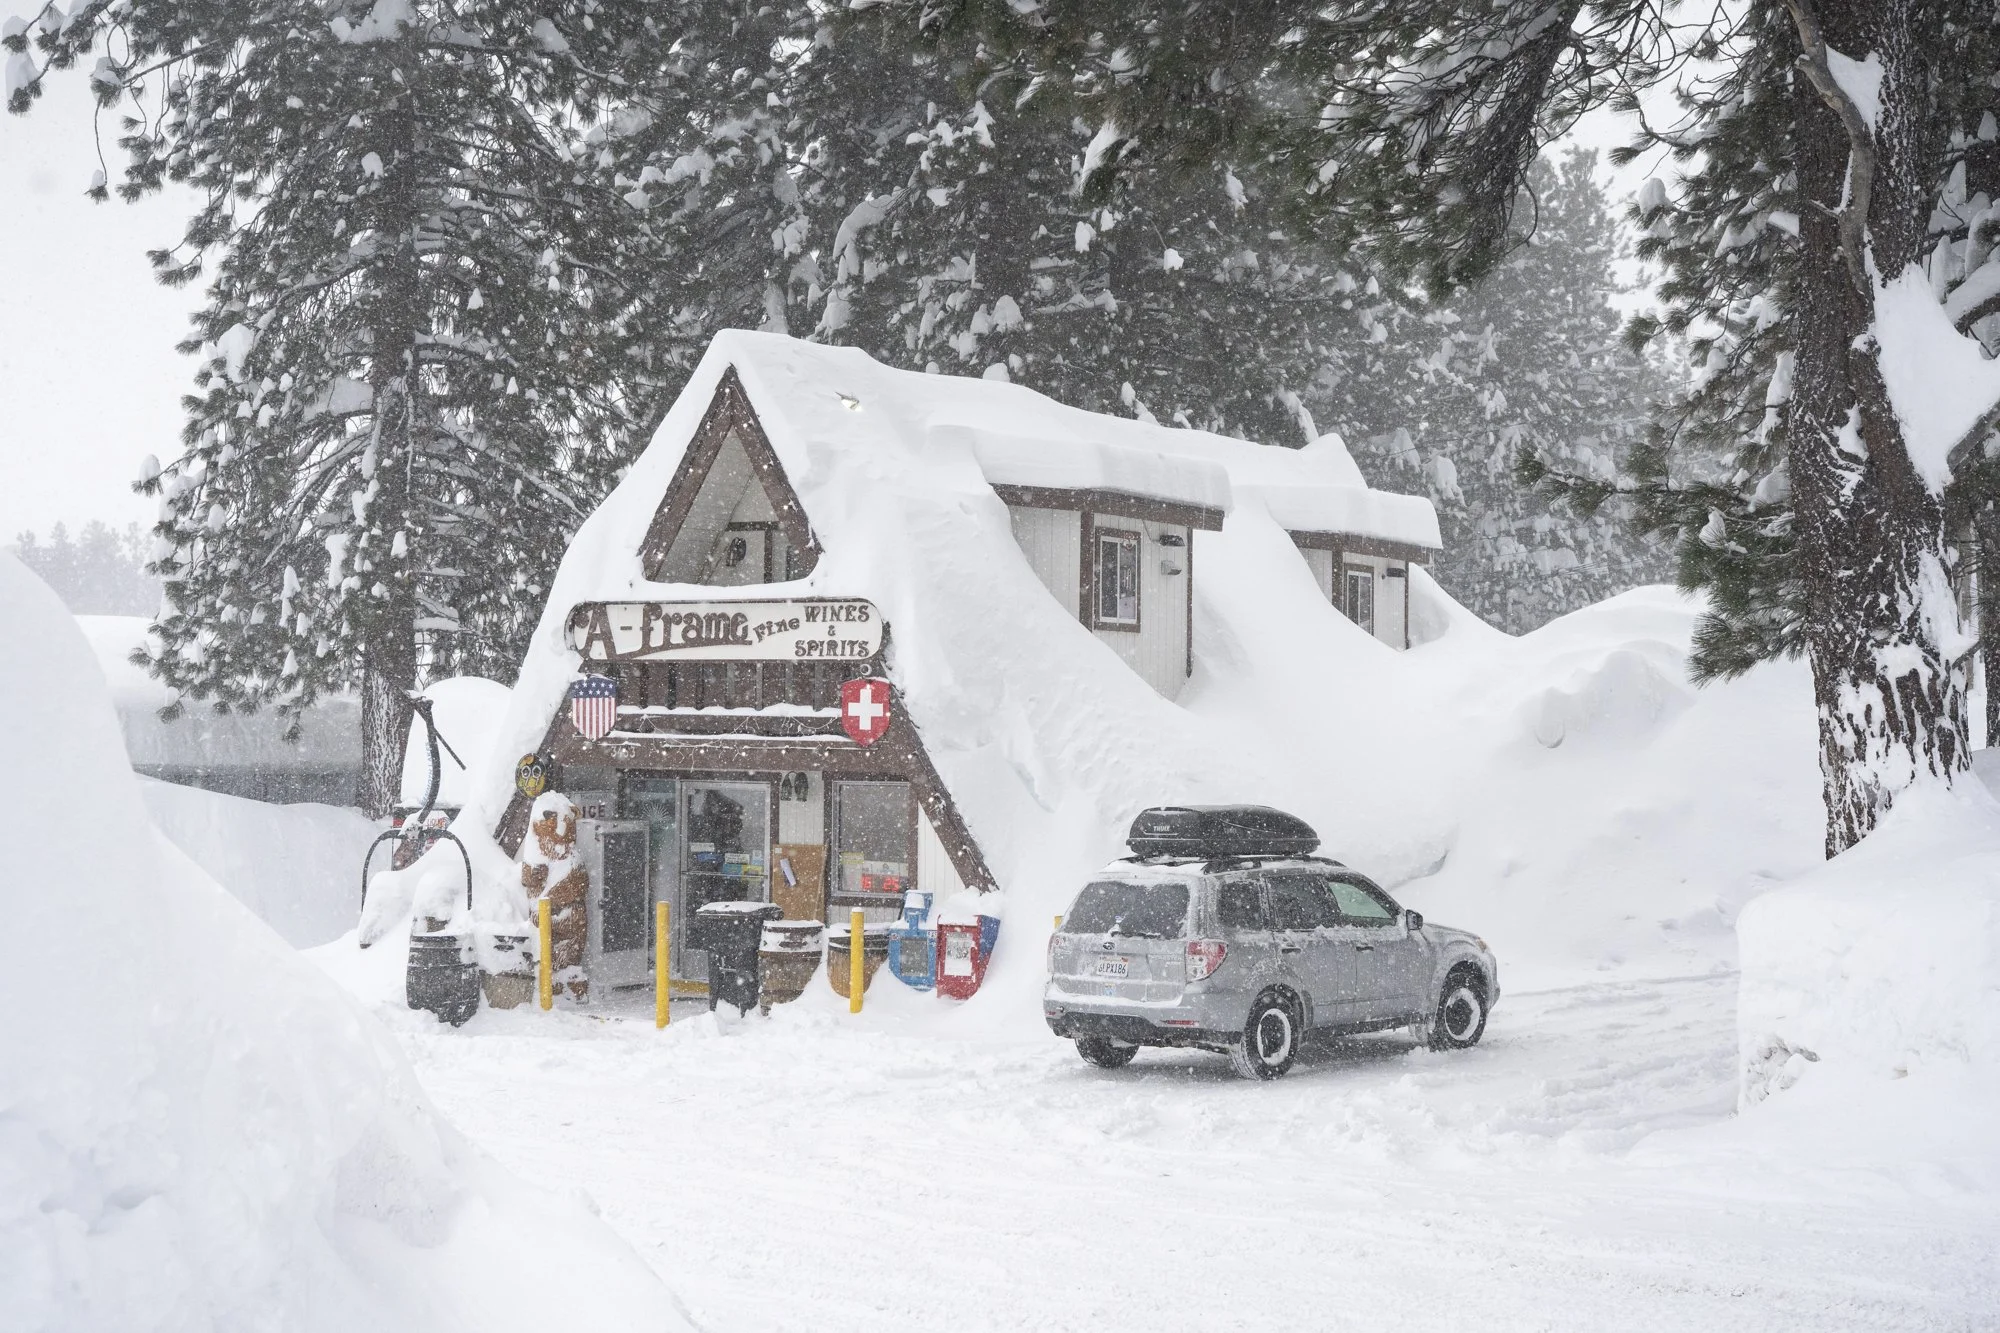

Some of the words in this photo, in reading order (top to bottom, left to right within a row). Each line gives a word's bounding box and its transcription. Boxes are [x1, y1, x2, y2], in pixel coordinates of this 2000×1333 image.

[804, 604, 870, 623] WINES
[753, 617, 800, 643] Fine
[827, 624, 836, 637] &
[795, 639, 870, 658] SPIRITS
[582, 804, 606, 819] ICE
